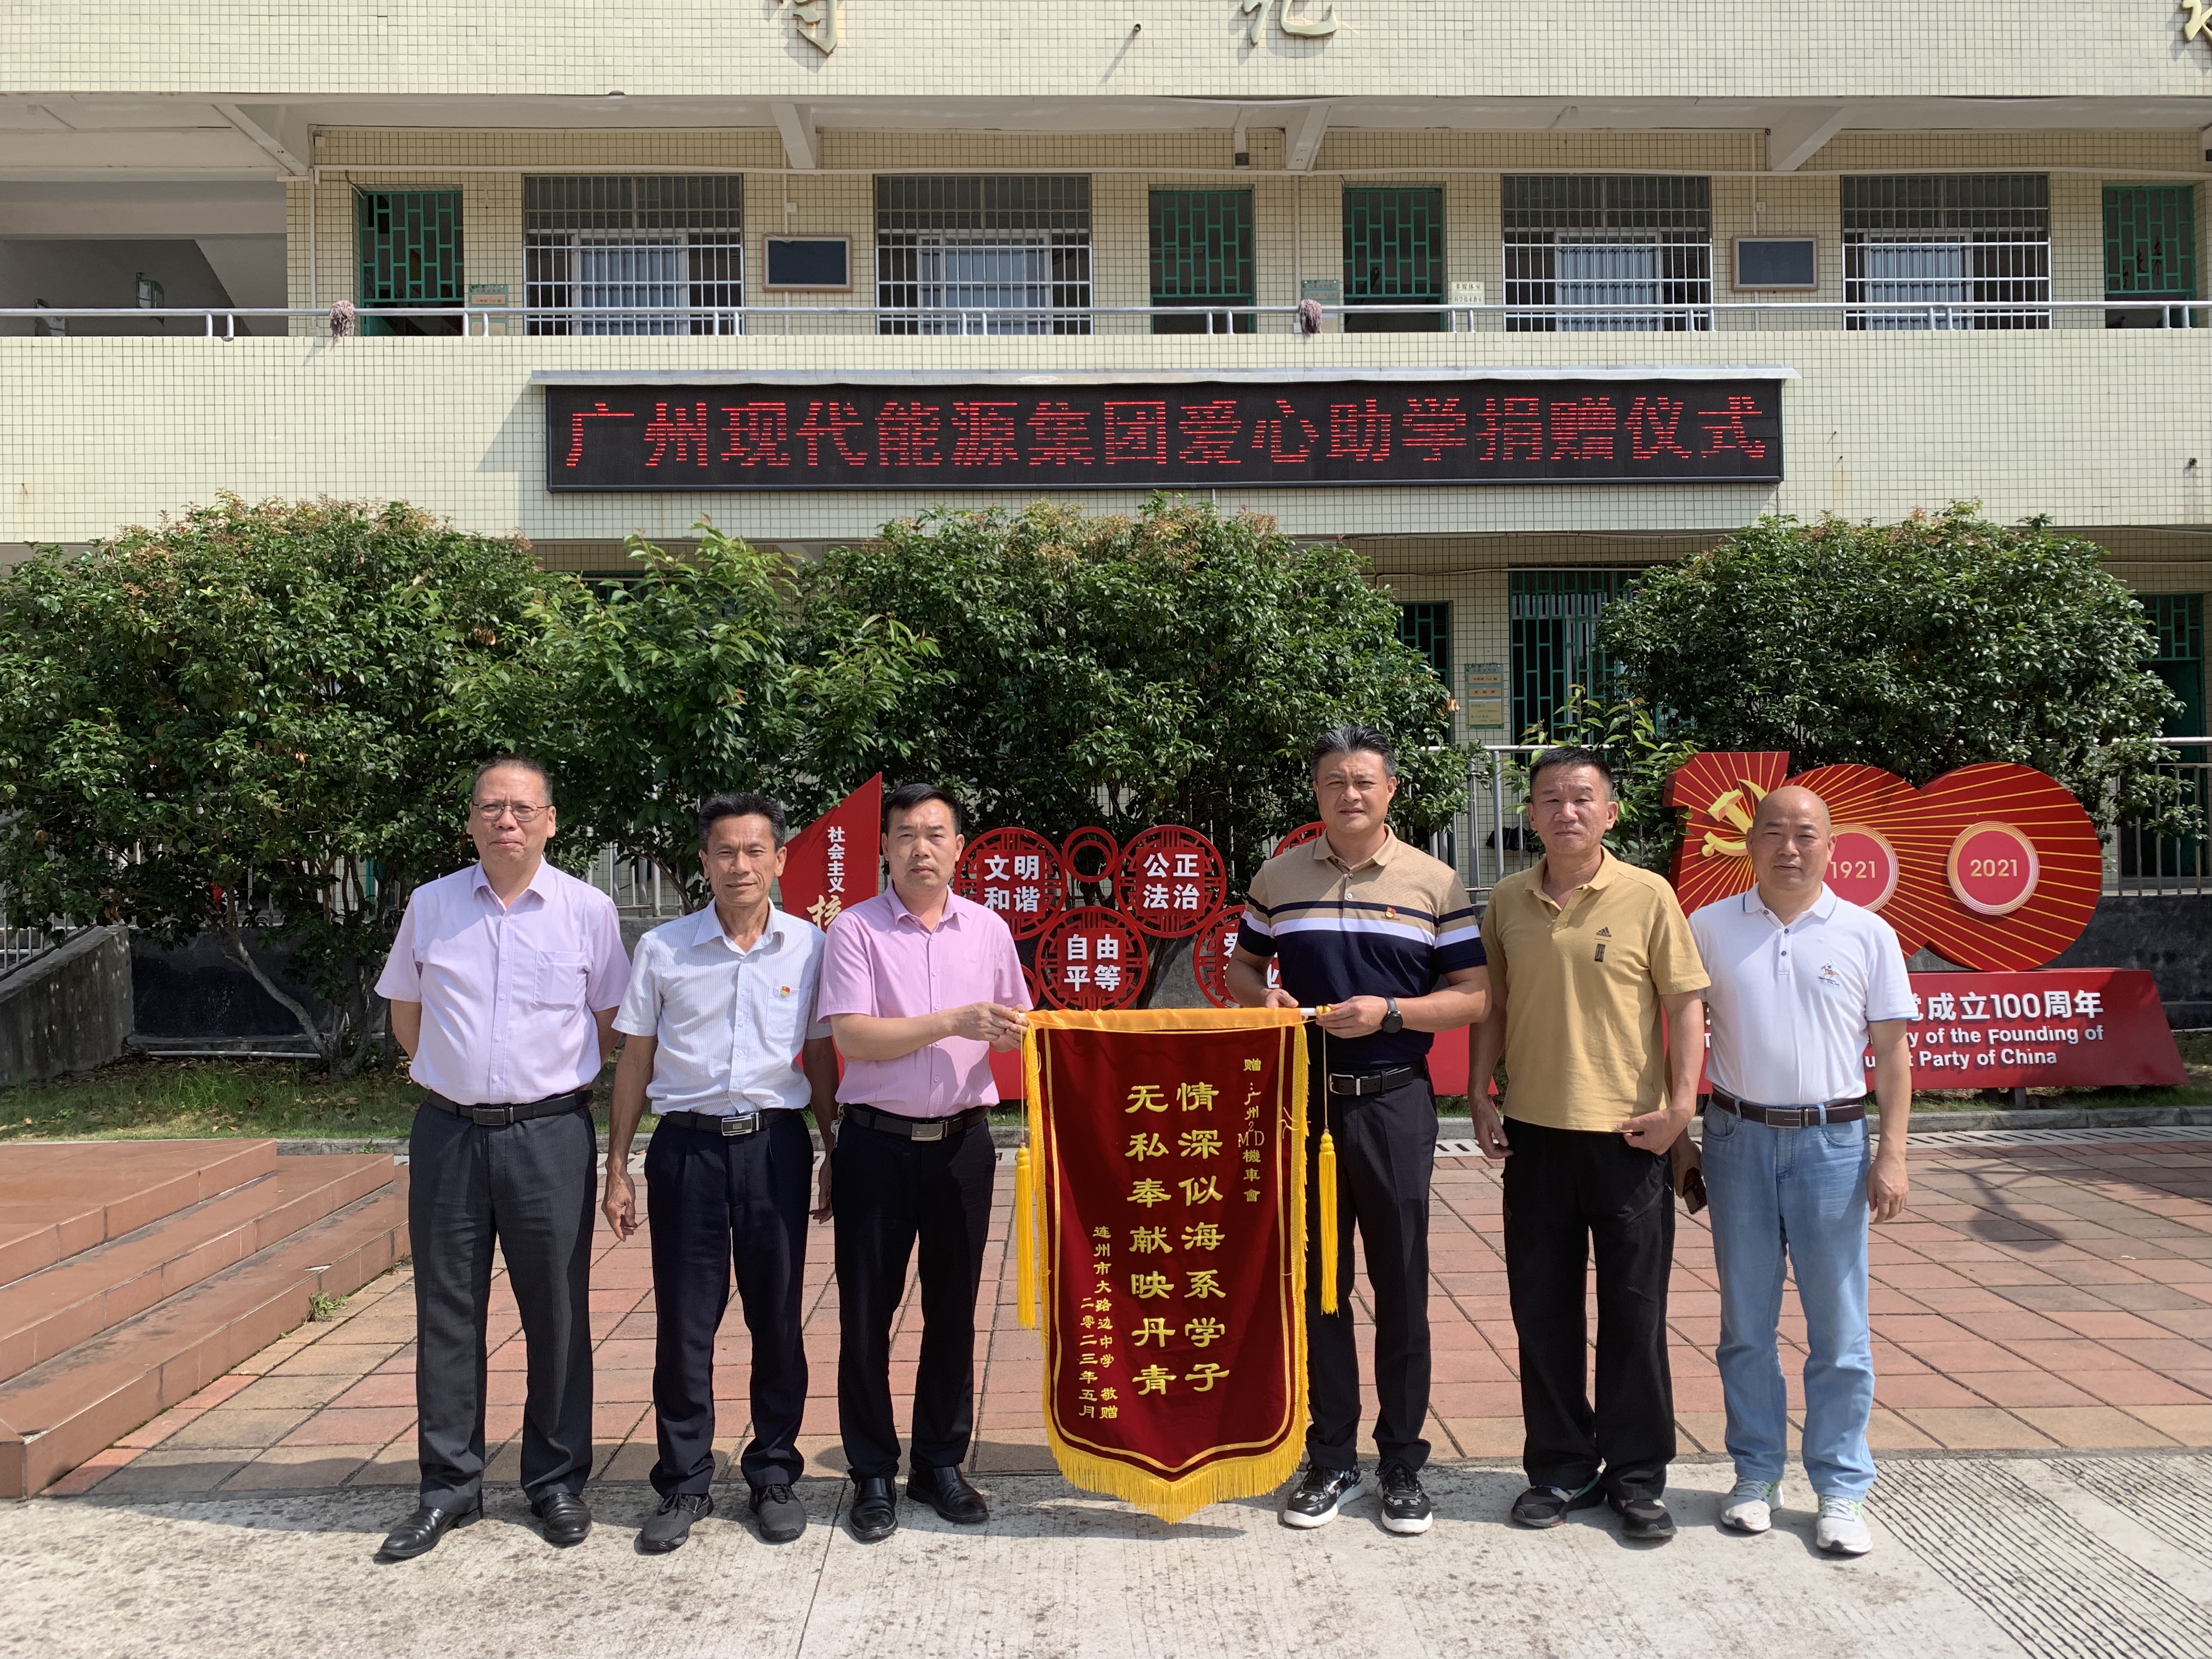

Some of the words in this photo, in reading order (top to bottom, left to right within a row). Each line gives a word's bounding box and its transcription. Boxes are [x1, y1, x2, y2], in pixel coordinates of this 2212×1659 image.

[566, 396, 1765, 467] 广州现代能源集团爱心助学捐赠仪式
[827, 826, 845, 893] 社会主义
[984, 854, 1040, 881] 文明
[1143, 852, 1200, 878] 公正
[1830, 861, 1876, 879] 1921
[1970, 859, 2018, 877] 2021
[984, 885, 1041, 913] 和谐
[1143, 883, 1200, 910] 法治
[1067, 934, 1119, 961] 自由
[1063, 964, 1121, 992] 平等
[1911, 990, 2104, 1021] 成立100周年
[1925, 1028, 1945, 1043] of
[1950, 1027, 1982, 1043] the
[1988, 1025, 2079, 1045] Founding
[2084, 1024, 2104, 1040] of
[1920, 1051, 1970, 1070] Party
[1976, 1049, 1996, 1065] of
[2000, 1048, 2058, 1065] China
[1125, 1085, 1177, 1396] 无私奉献映丹青
[1176, 1081, 1230, 1392] 情深似海系学子
[1092, 1225, 1114, 1368] 连州市大路边中学
[1079, 1297, 1098, 1419] 二零二三年五月
[1099, 1387, 1119, 1420] 敬赠
